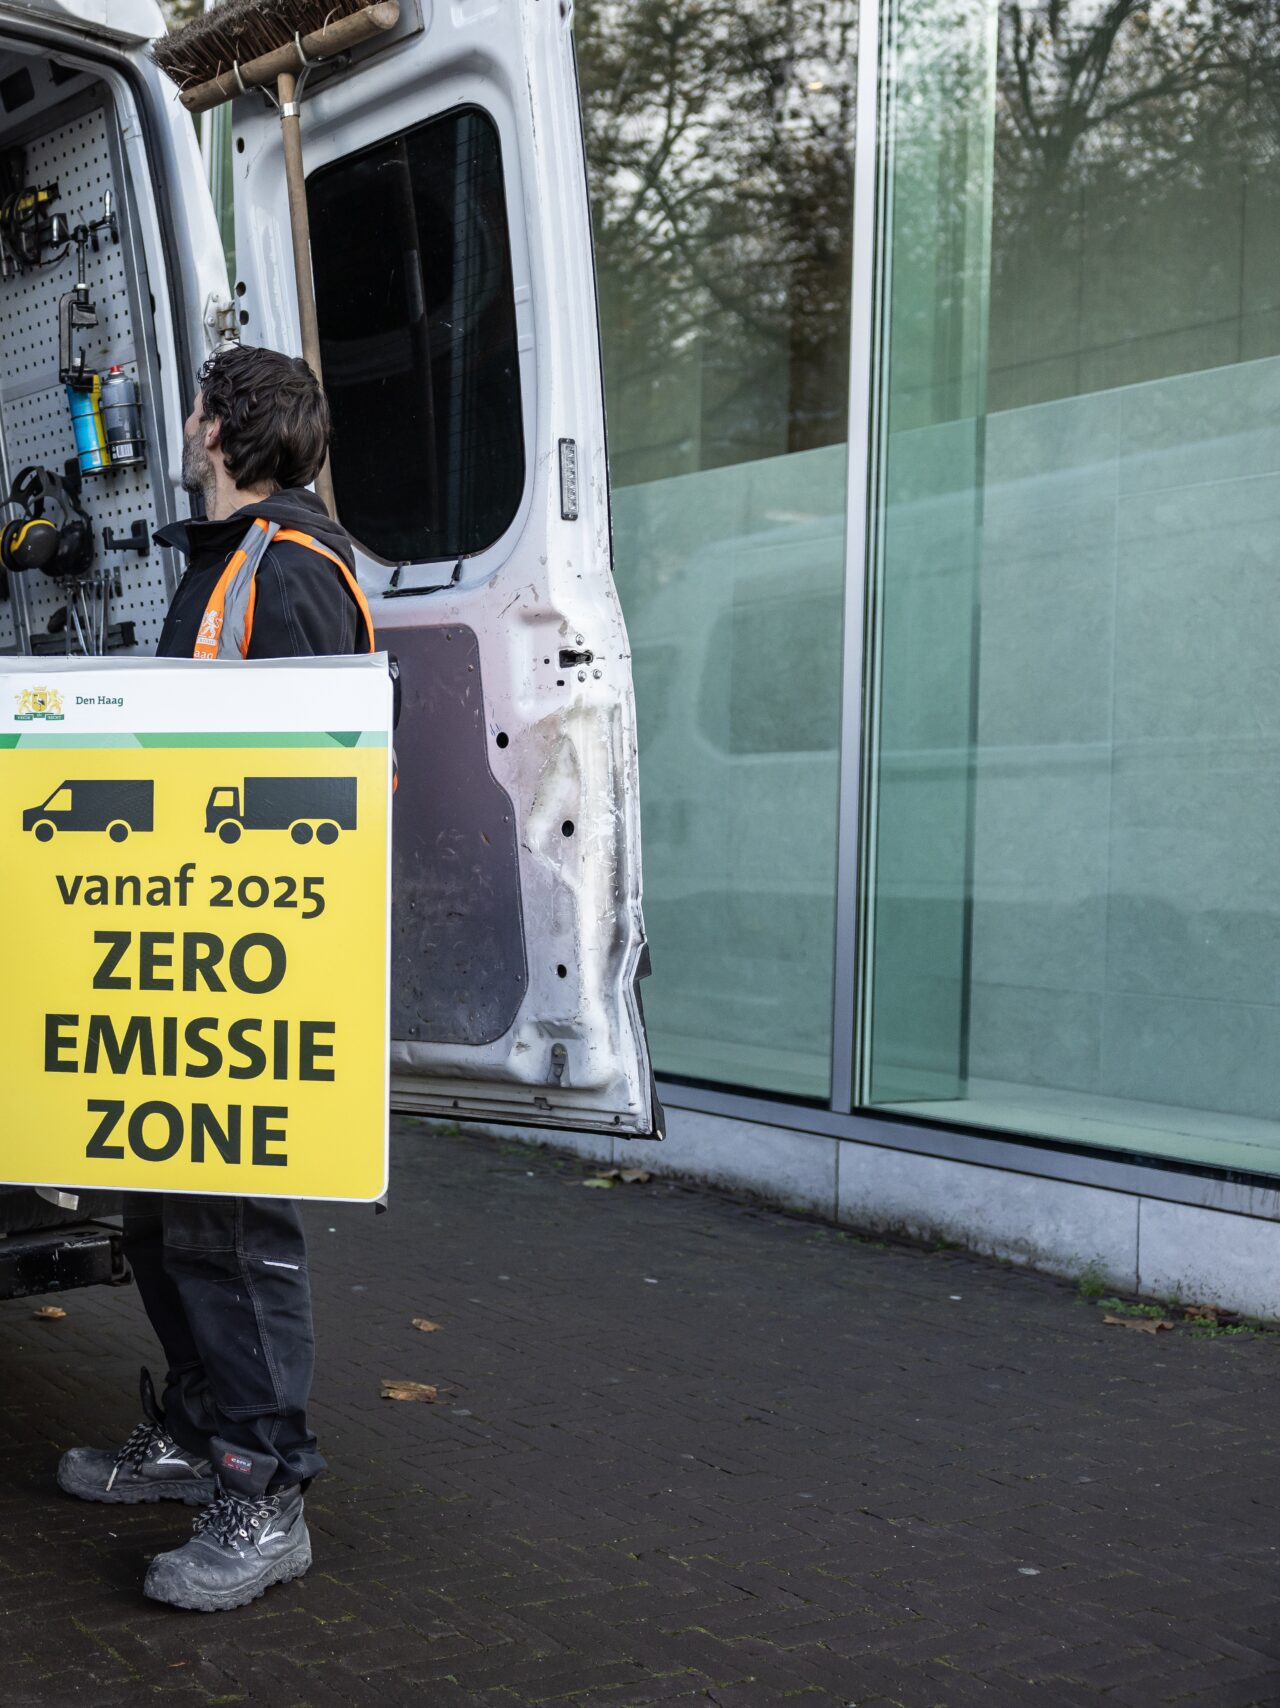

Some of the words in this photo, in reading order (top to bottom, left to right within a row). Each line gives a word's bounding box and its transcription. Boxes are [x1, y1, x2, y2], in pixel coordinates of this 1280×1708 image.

[76, 696, 95, 705] Den
[97, 696, 124, 707] Haag
[56, 862, 196, 907] vanaf
[209, 874, 326, 919] 2025
[92, 930, 287, 995] ZERO
[43, 1013, 336, 1082] EMISSIE
[85, 1098, 289, 1167] ZONE
